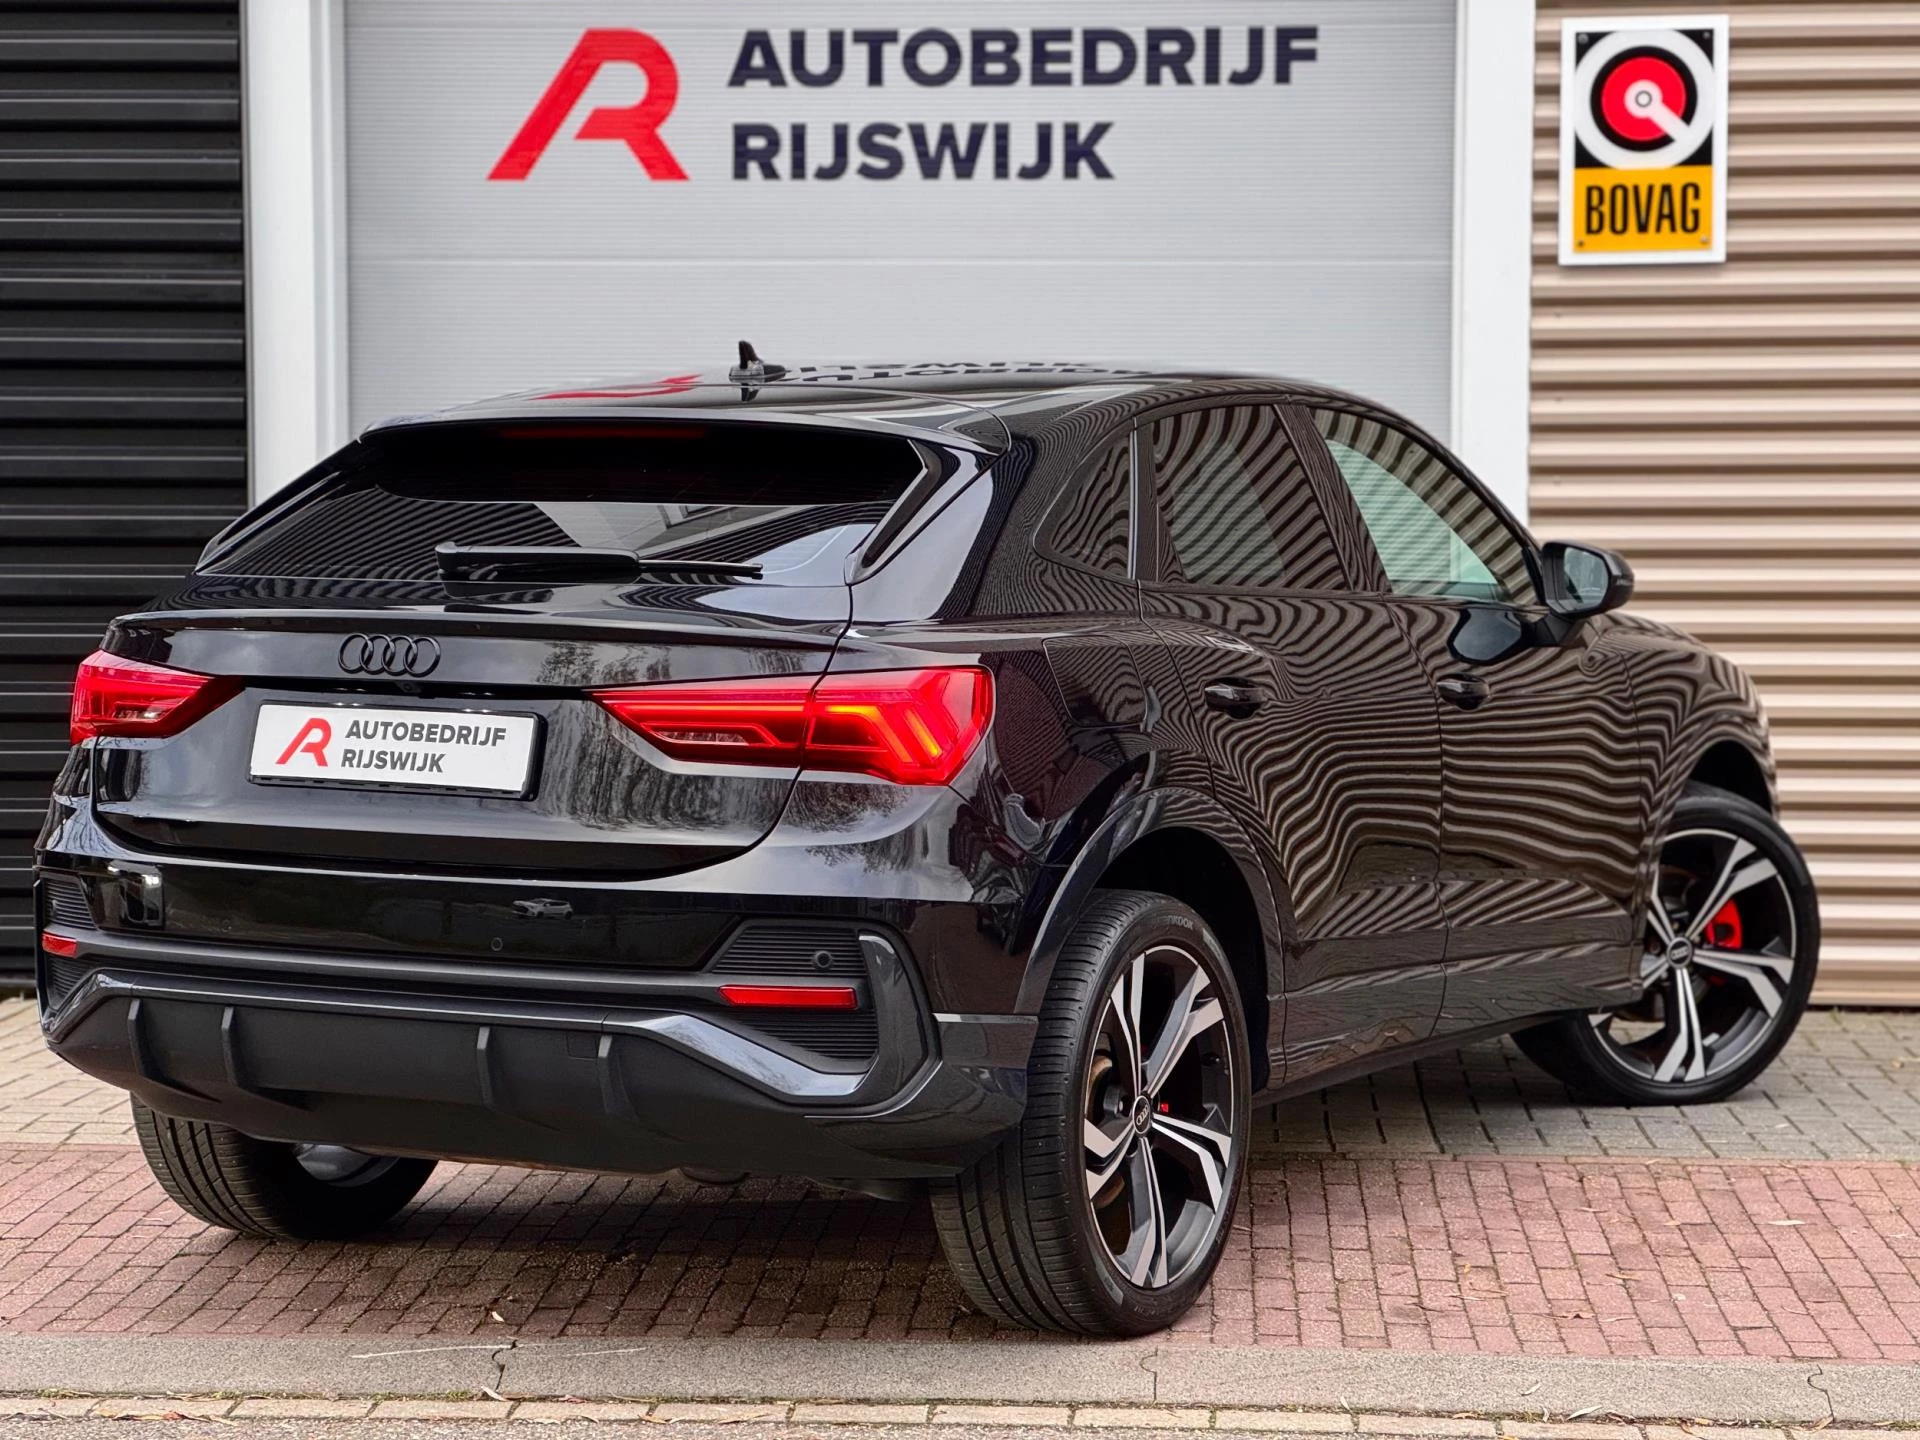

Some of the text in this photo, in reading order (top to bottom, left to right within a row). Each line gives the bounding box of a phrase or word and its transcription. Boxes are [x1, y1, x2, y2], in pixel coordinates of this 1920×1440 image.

[728, 26, 1319, 88] AUTOBEDRIJF
[732, 122, 1114, 181] RIJSWIJK
[1585, 182, 1701, 235] BOVAG
[345, 719, 506, 746] AUTOBEDRIJF
[341, 748, 446, 773] RIJSWIJK
